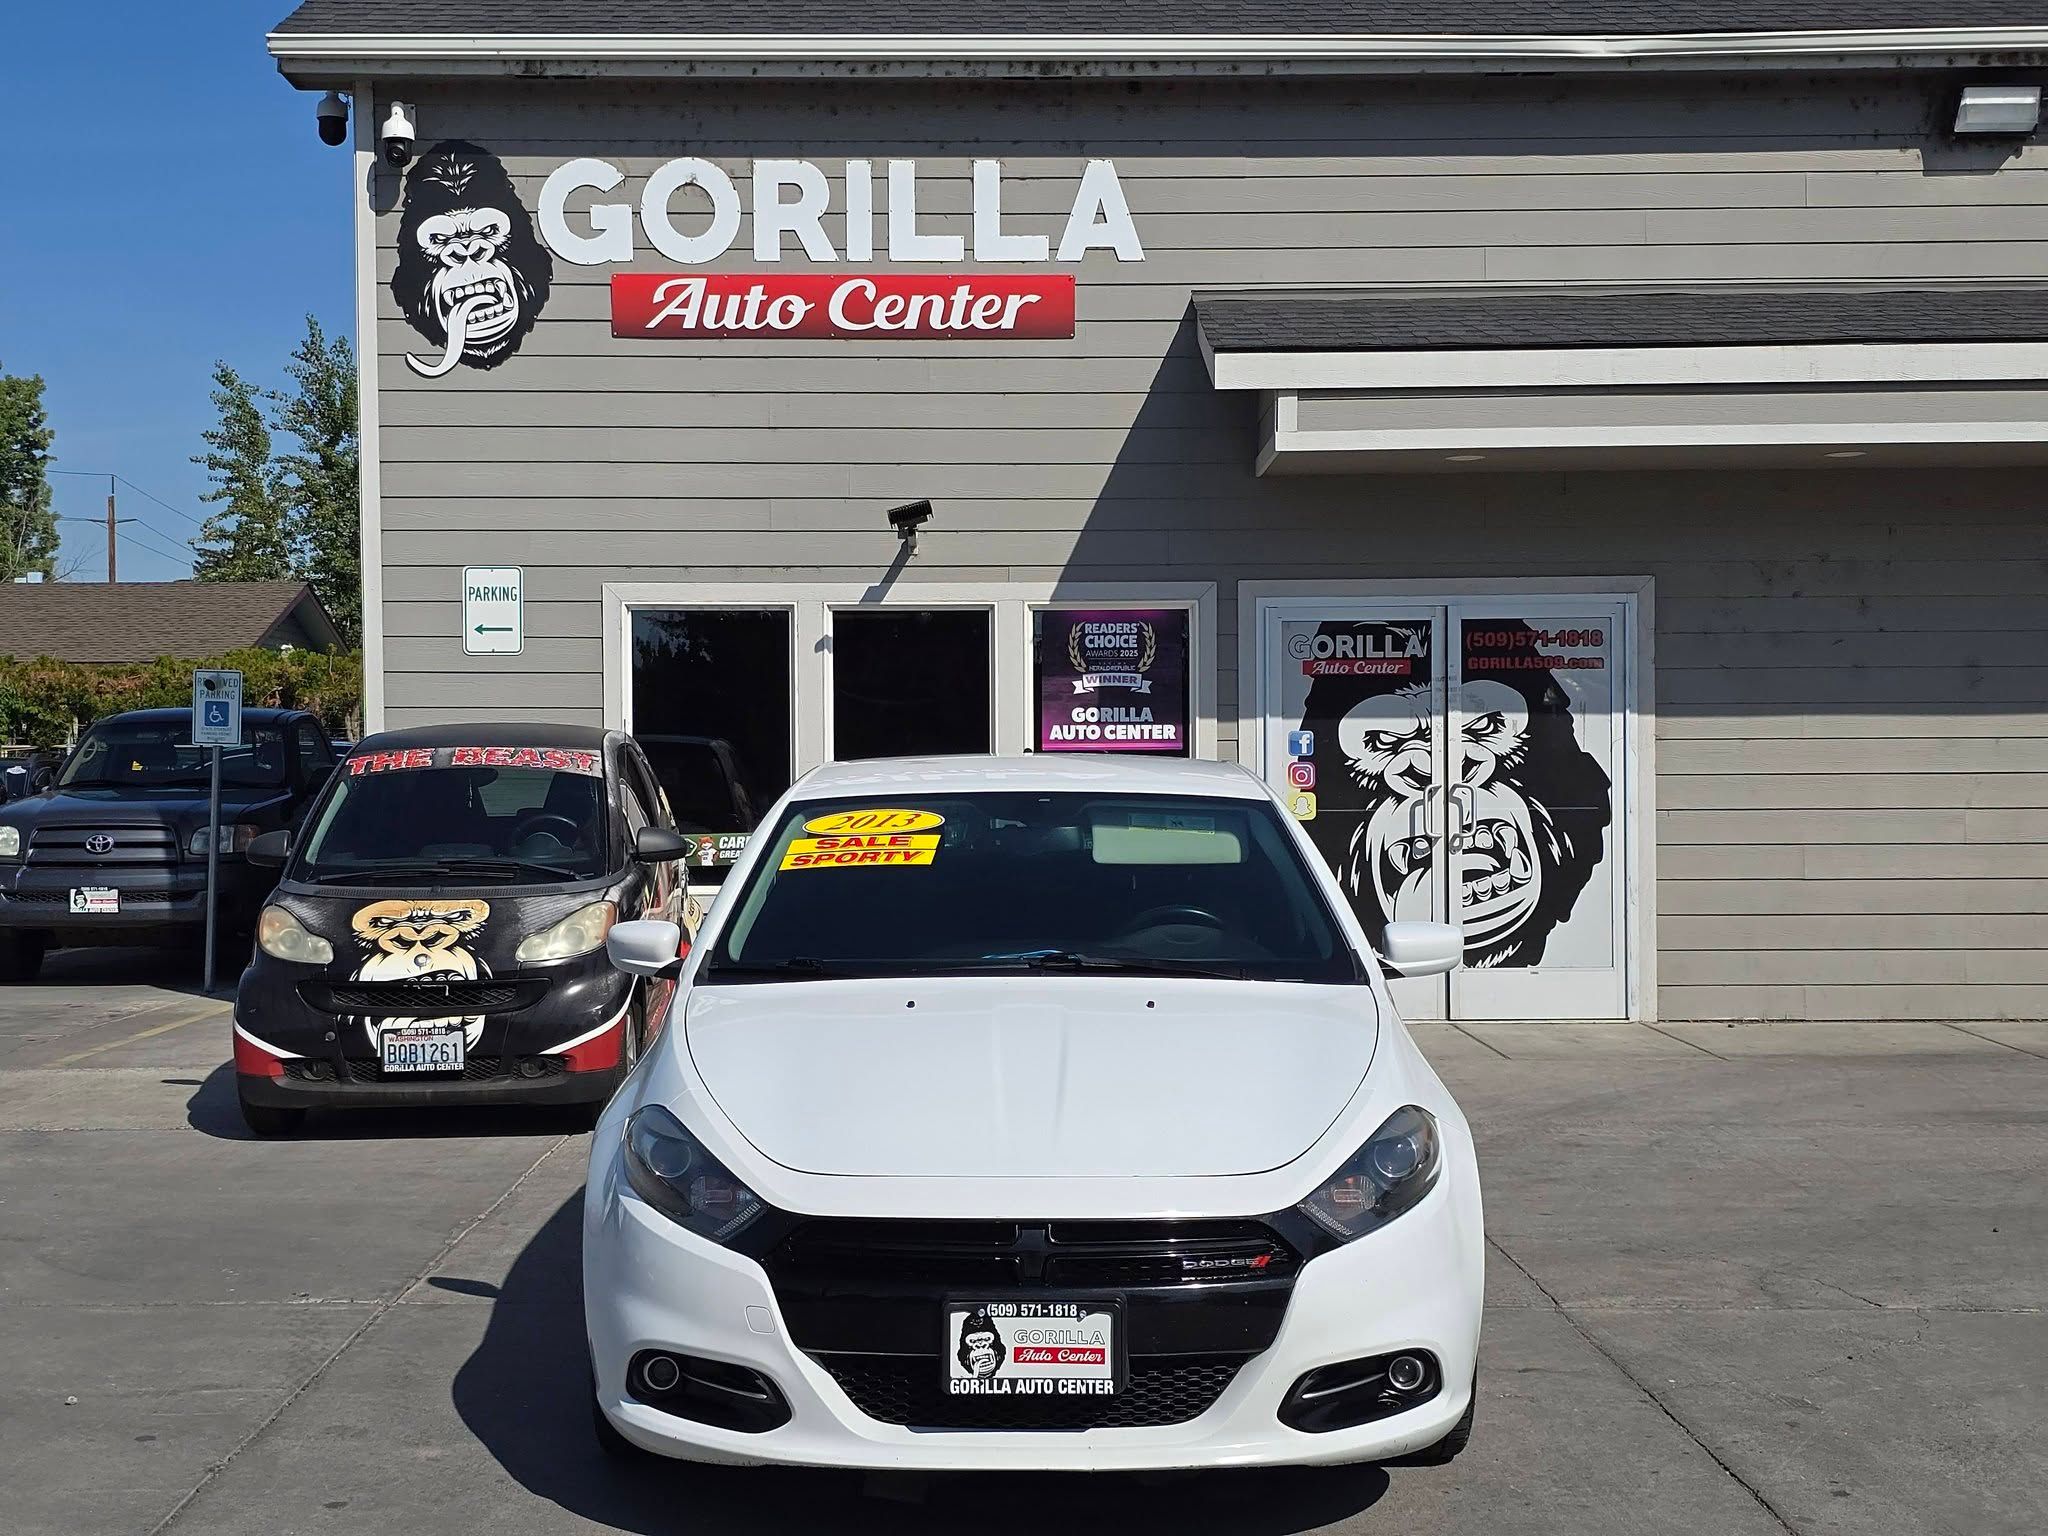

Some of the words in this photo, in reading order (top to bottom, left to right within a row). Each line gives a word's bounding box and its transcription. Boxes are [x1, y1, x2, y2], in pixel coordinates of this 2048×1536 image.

[538, 158, 1145, 265] GORILLA
[646, 277, 814, 331] Auto
[827, 277, 1041, 331] Center
[468, 586, 518, 602] PARKING
[1084, 634, 1138, 648] CHOICE
[1288, 633, 1425, 659] GORILLA
[1465, 629, 1604, 651] (509)571-1818
[1085, 649, 1119, 658] AWARDS
[1120, 649, 1139, 658] 2025
[1312, 660, 1350, 675] Auto
[1353, 660, 1404, 675] Center
[1467, 655, 1605, 670] GORILLA509.com
[1085, 674, 1138, 685] WINNER
[1071, 706, 1154, 723] GORILLA
[1049, 724, 1101, 741] AUTO
[1104, 724, 1177, 741] CENTER
[346, 748, 435, 776] THE
[451, 747, 600, 772] BEAST
[825, 813, 922, 831] 2013
[815, 836, 913, 849] SALE
[719, 850, 743, 859] GREA
[790, 850, 925, 867] SPORTY
[388, 1035, 434, 1043] WASHINGTON
[387, 1042, 458, 1063] BQB1261
[416, 1063, 435, 1071] AUTO
[436, 1063, 464, 1071] CENTER
[1182, 1258, 1259, 1269] DODGE
[986, 1303, 1017, 1317] (509)
[1020, 1303, 1078, 1317] 571-1818
[1013, 1329, 1106, 1345] GORILLA
[1018, 1349, 1053, 1362] Auto
[1057, 1349, 1103, 1362] Center
[1015, 1379, 1053, 1395] AUTO
[1057, 1379, 1114, 1395] CENTER
